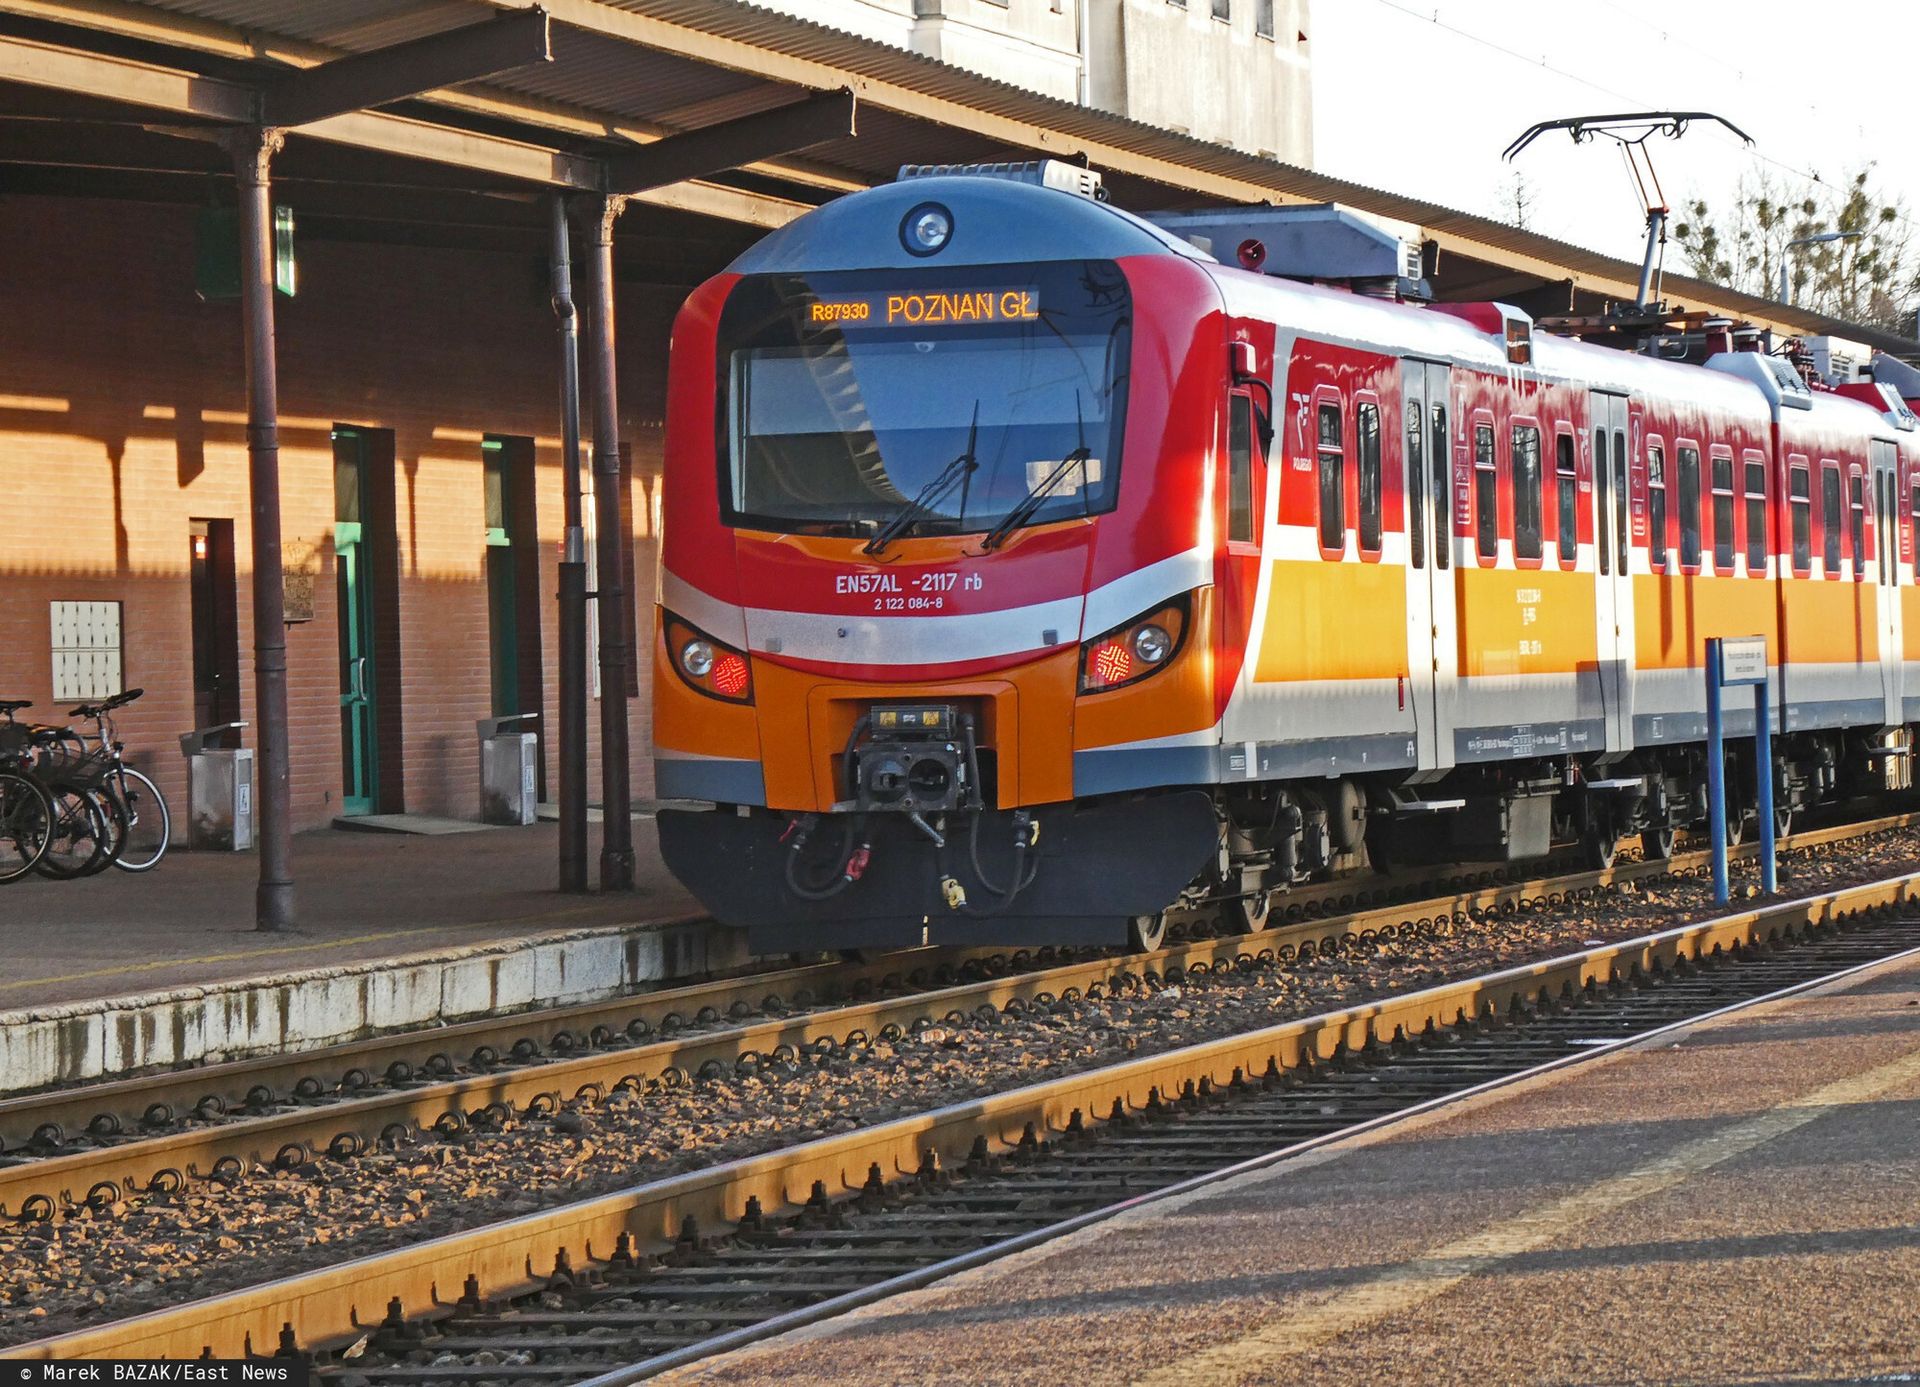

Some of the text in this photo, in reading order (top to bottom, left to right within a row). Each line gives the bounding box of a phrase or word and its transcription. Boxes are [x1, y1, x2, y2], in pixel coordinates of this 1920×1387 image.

[812, 291, 1040, 323] R87930 POZNAŃ GŁ.
[836, 573, 982, 594] EN57AL -2117 rb
[874, 597, 943, 611] 2 122 084-8
